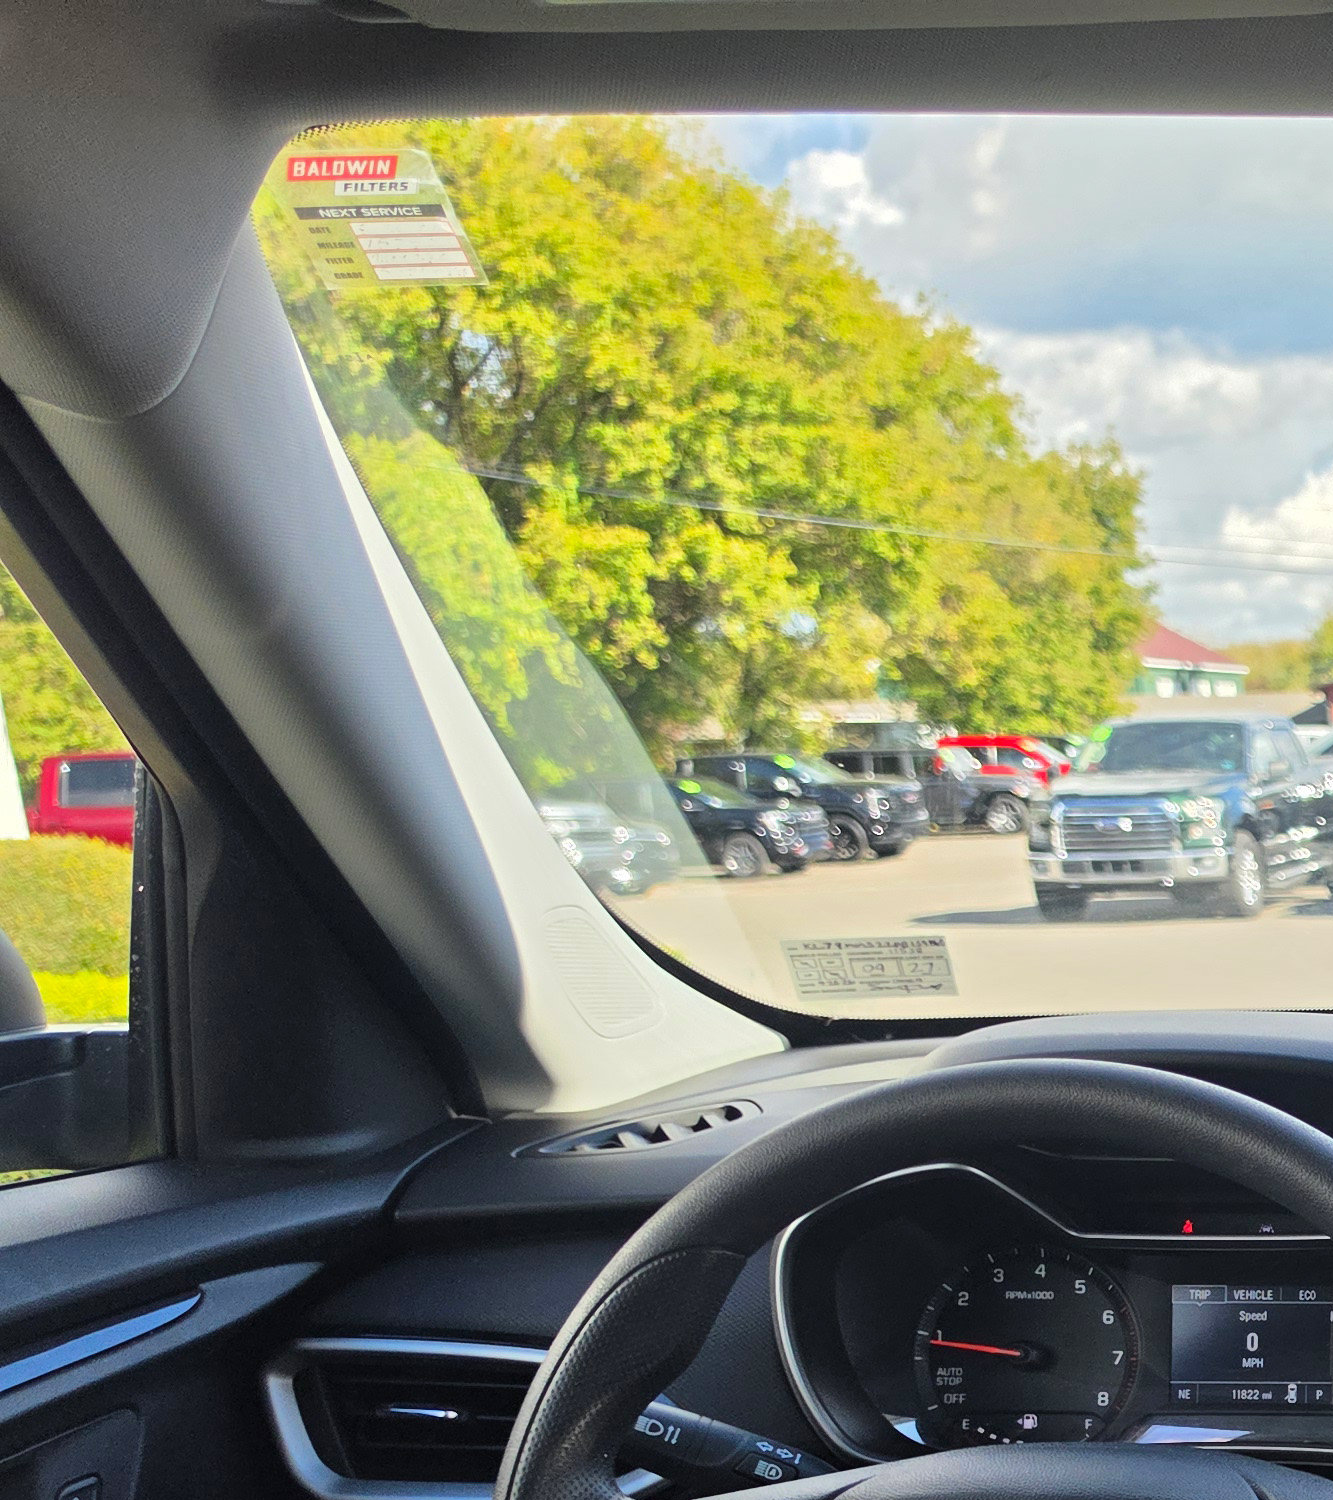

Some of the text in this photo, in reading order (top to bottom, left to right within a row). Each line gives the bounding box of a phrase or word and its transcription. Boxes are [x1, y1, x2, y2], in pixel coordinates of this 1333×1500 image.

[293, 159, 391, 177] BALDWIN
[343, 181, 409, 192] FILTERS
[319, 206, 423, 218] NEXT SERVICE
[993, 1269, 1005, 1283] 3
[1035, 1263, 1047, 1279] 4
[1074, 1280, 1086, 1294] 5
[957, 1291, 970, 1306] 2
[1189, 1289, 1316, 1301] TRIP VEHICLE ECO
[1102, 1309, 1114, 1325] 6
[1239, 1310, 1268, 1322] Speed
[936, 1329, 943, 1342] 1
[1246, 1332, 1259, 1352] 0
[1112, 1350, 1124, 1366] 7
[1242, 1357, 1264, 1368] MPH
[937, 1367, 963, 1376] AUTO
[936, 1377, 963, 1386] STOP
[944, 1393, 967, 1404] OFF
[1097, 1391, 1109, 1407] 8
[1178, 1389, 1191, 1400] NE
[1232, 1389, 1259, 1400] 11822
[1315, 1389, 1324, 1400] P
[962, 1419, 970, 1430] E
[1084, 1419, 1092, 1430] F
